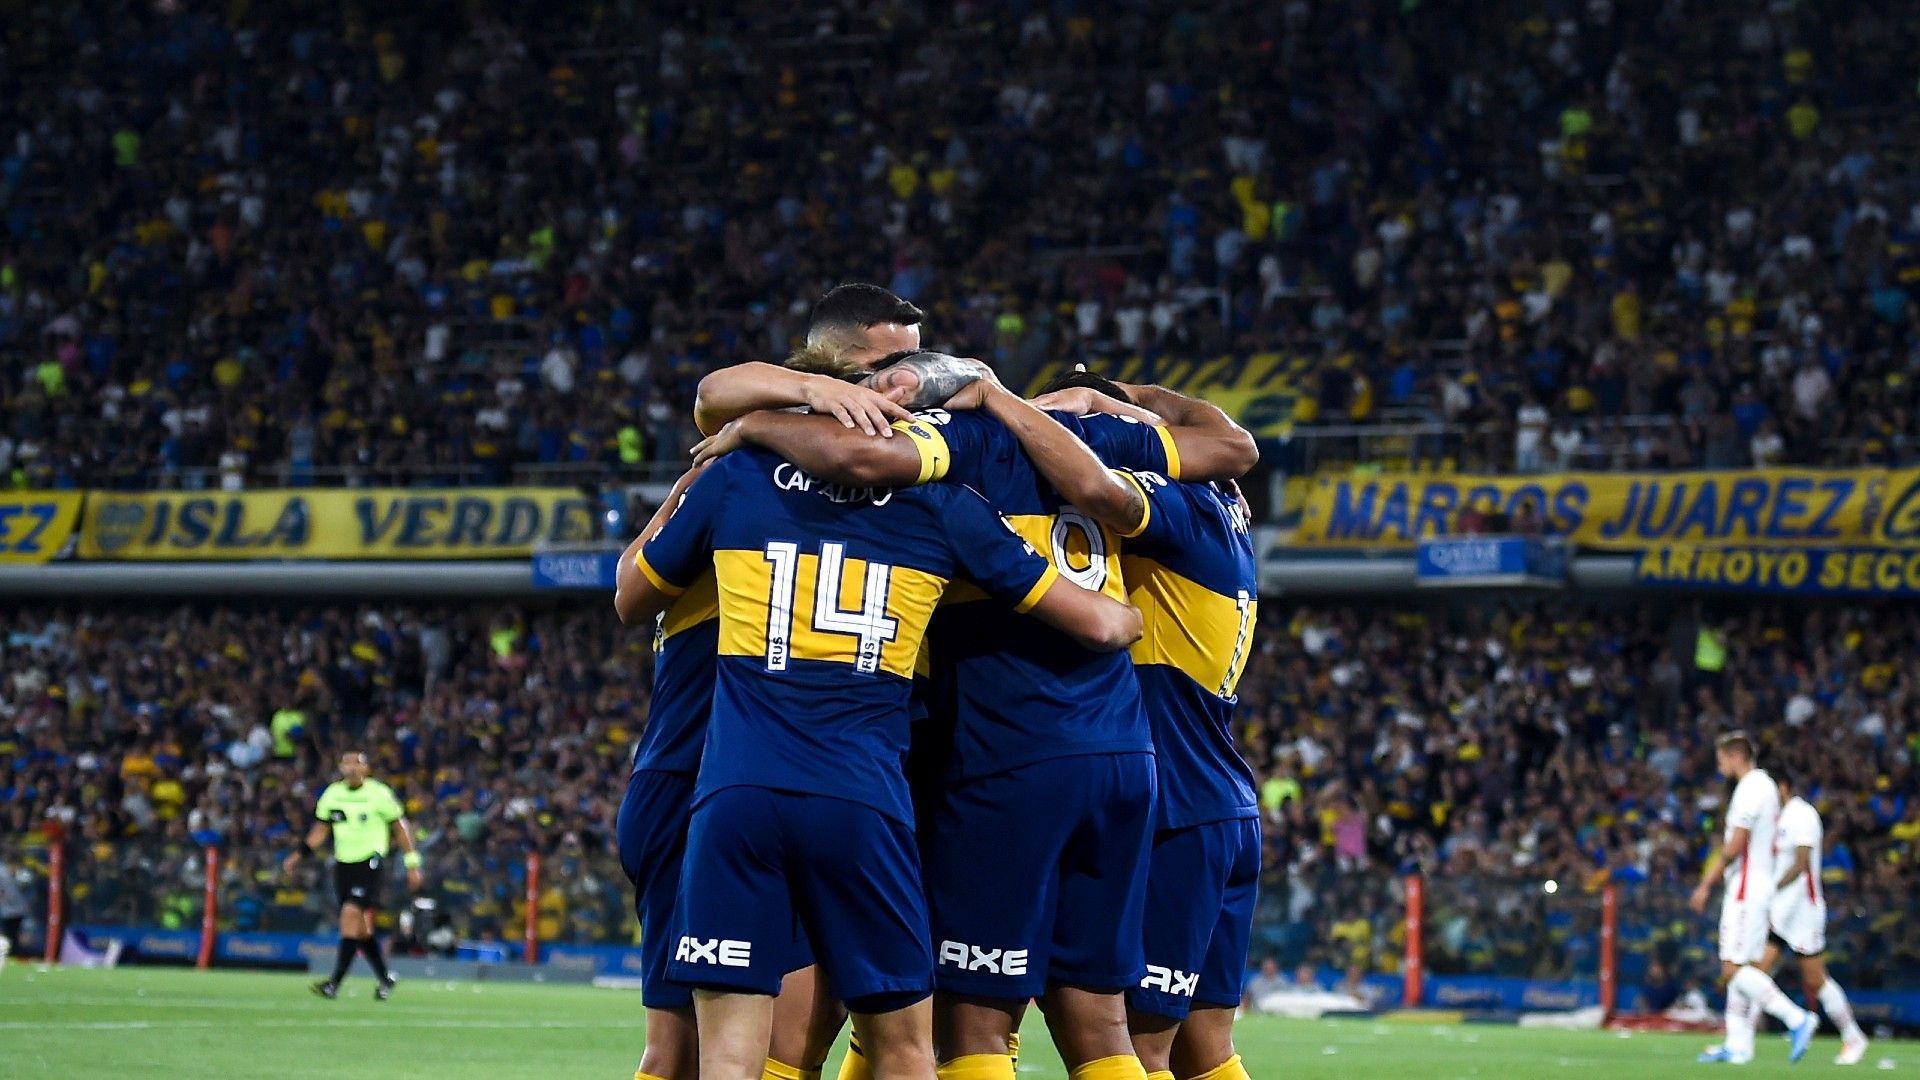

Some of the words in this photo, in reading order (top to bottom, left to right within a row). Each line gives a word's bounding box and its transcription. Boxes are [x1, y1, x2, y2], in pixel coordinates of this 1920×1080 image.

[773, 462, 893, 507] CAPALDO
[144, 498, 311, 546] ISLA
[355, 496, 592, 547] VERDE
[1602, 477, 1856, 540] JUAREZ
[1637, 545, 1809, 588] ARROYO
[764, 539, 898, 675] 14
[772, 636, 783, 666] RUS
[862, 642, 875, 671] RUS
[675, 935, 752, 968] AXE
[939, 939, 1029, 976] AXE
[1140, 964, 1200, 998] AX
